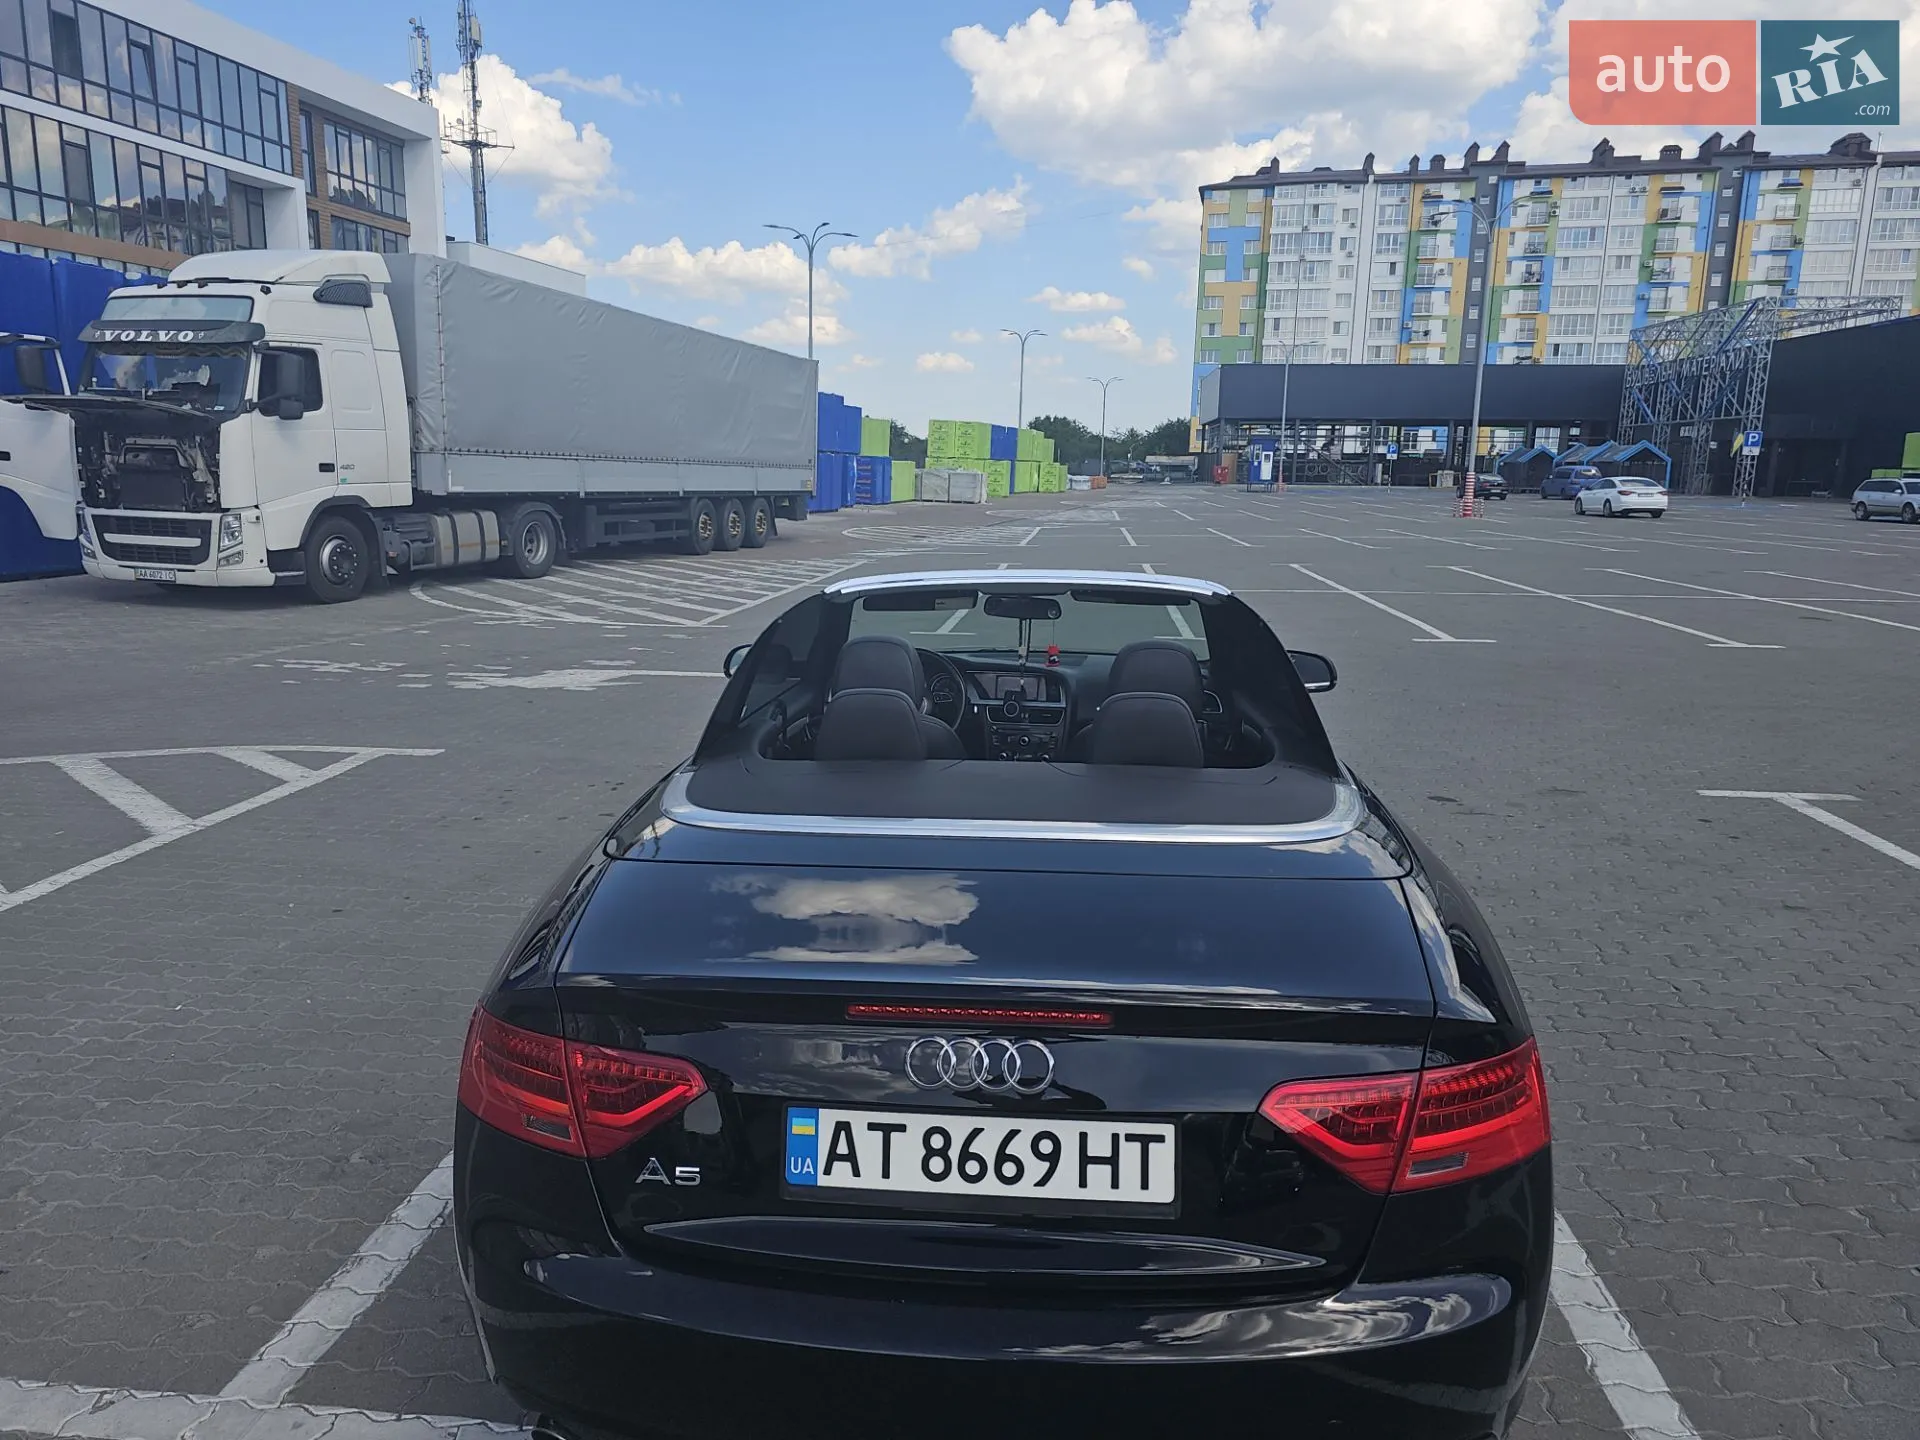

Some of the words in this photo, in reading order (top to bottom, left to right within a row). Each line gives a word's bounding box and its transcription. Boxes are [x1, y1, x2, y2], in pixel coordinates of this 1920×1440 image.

[103, 330, 194, 342] VOLVO
[1680, 350, 1746, 378] МАТЕРІАЛИ
[1390, 445, 1397, 453] P
[1748, 433, 1759, 446] P
[823, 1121, 906, 1179] AT
[921, 1126, 1062, 1187] 8669
[1078, 1131, 1165, 1190] HT
[635, 1157, 701, 1186] A5
[790, 1156, 814, 1176] UA
